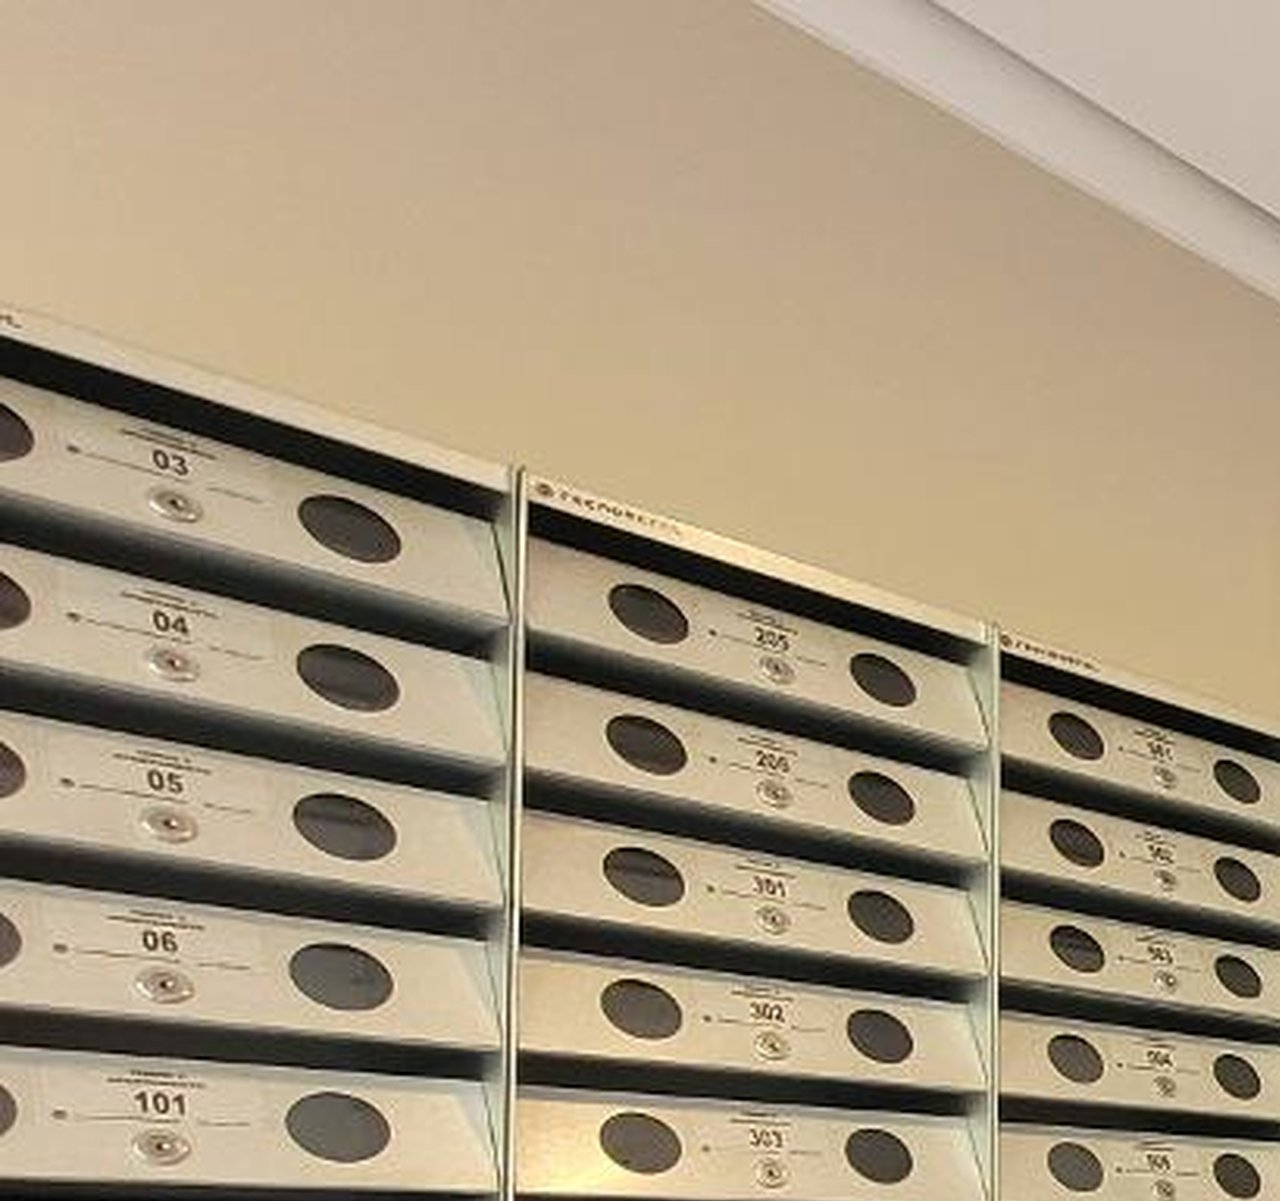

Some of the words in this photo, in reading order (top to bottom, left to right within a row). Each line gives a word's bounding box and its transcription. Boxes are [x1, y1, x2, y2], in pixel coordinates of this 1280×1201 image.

[151, 448, 189, 477] 03
[152, 611, 189, 637] 04
[147, 769, 183, 794] 05
[142, 929, 178, 952] 06
[750, 1003, 785, 1023] 302
[135, 1090, 186, 1115] 101
